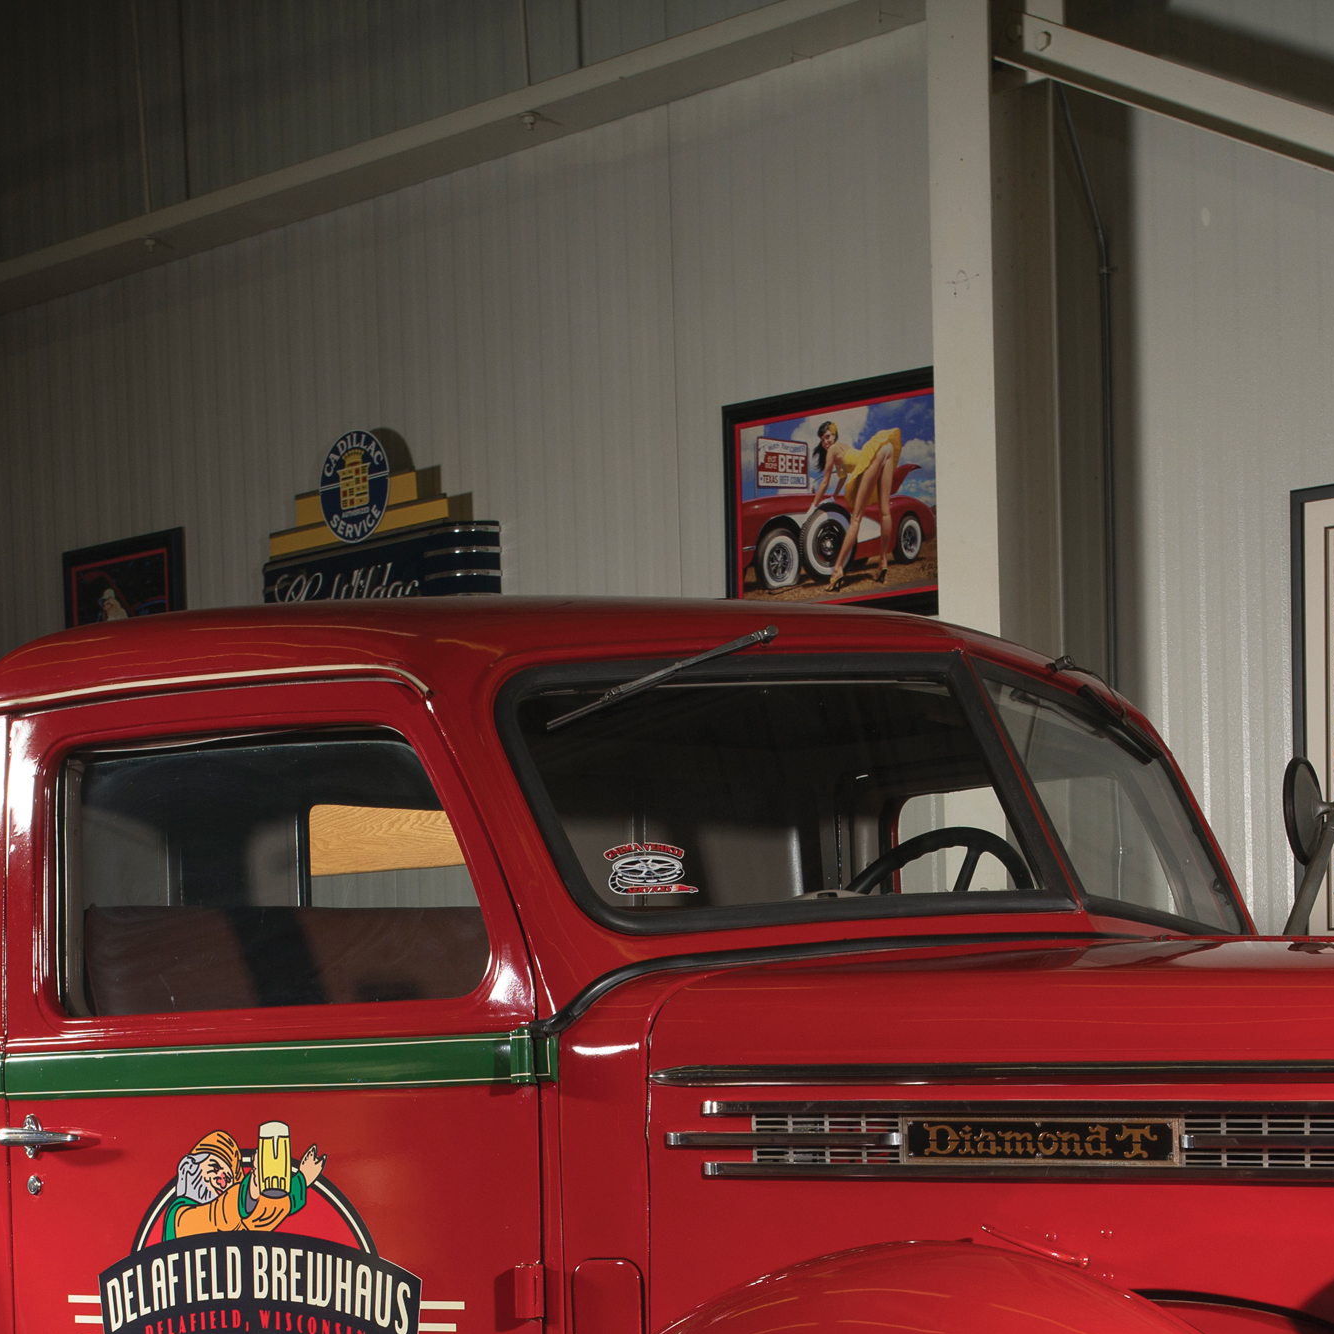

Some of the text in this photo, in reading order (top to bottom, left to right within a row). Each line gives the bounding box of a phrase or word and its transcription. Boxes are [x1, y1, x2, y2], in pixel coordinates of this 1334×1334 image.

[323, 432, 384, 477] CADILLAC
[778, 454, 805, 473] BEEF
[765, 462, 777, 470] more
[763, 474, 778, 484] TEXAS
[329, 504, 381, 539] SERVICE
[604, 843, 684, 860] CINEMA VEHICLE
[626, 885, 673, 894] SERVICES
[922, 1123, 1159, 1159] Diamond T
[106, 1245, 243, 1333] DELAFIELD
